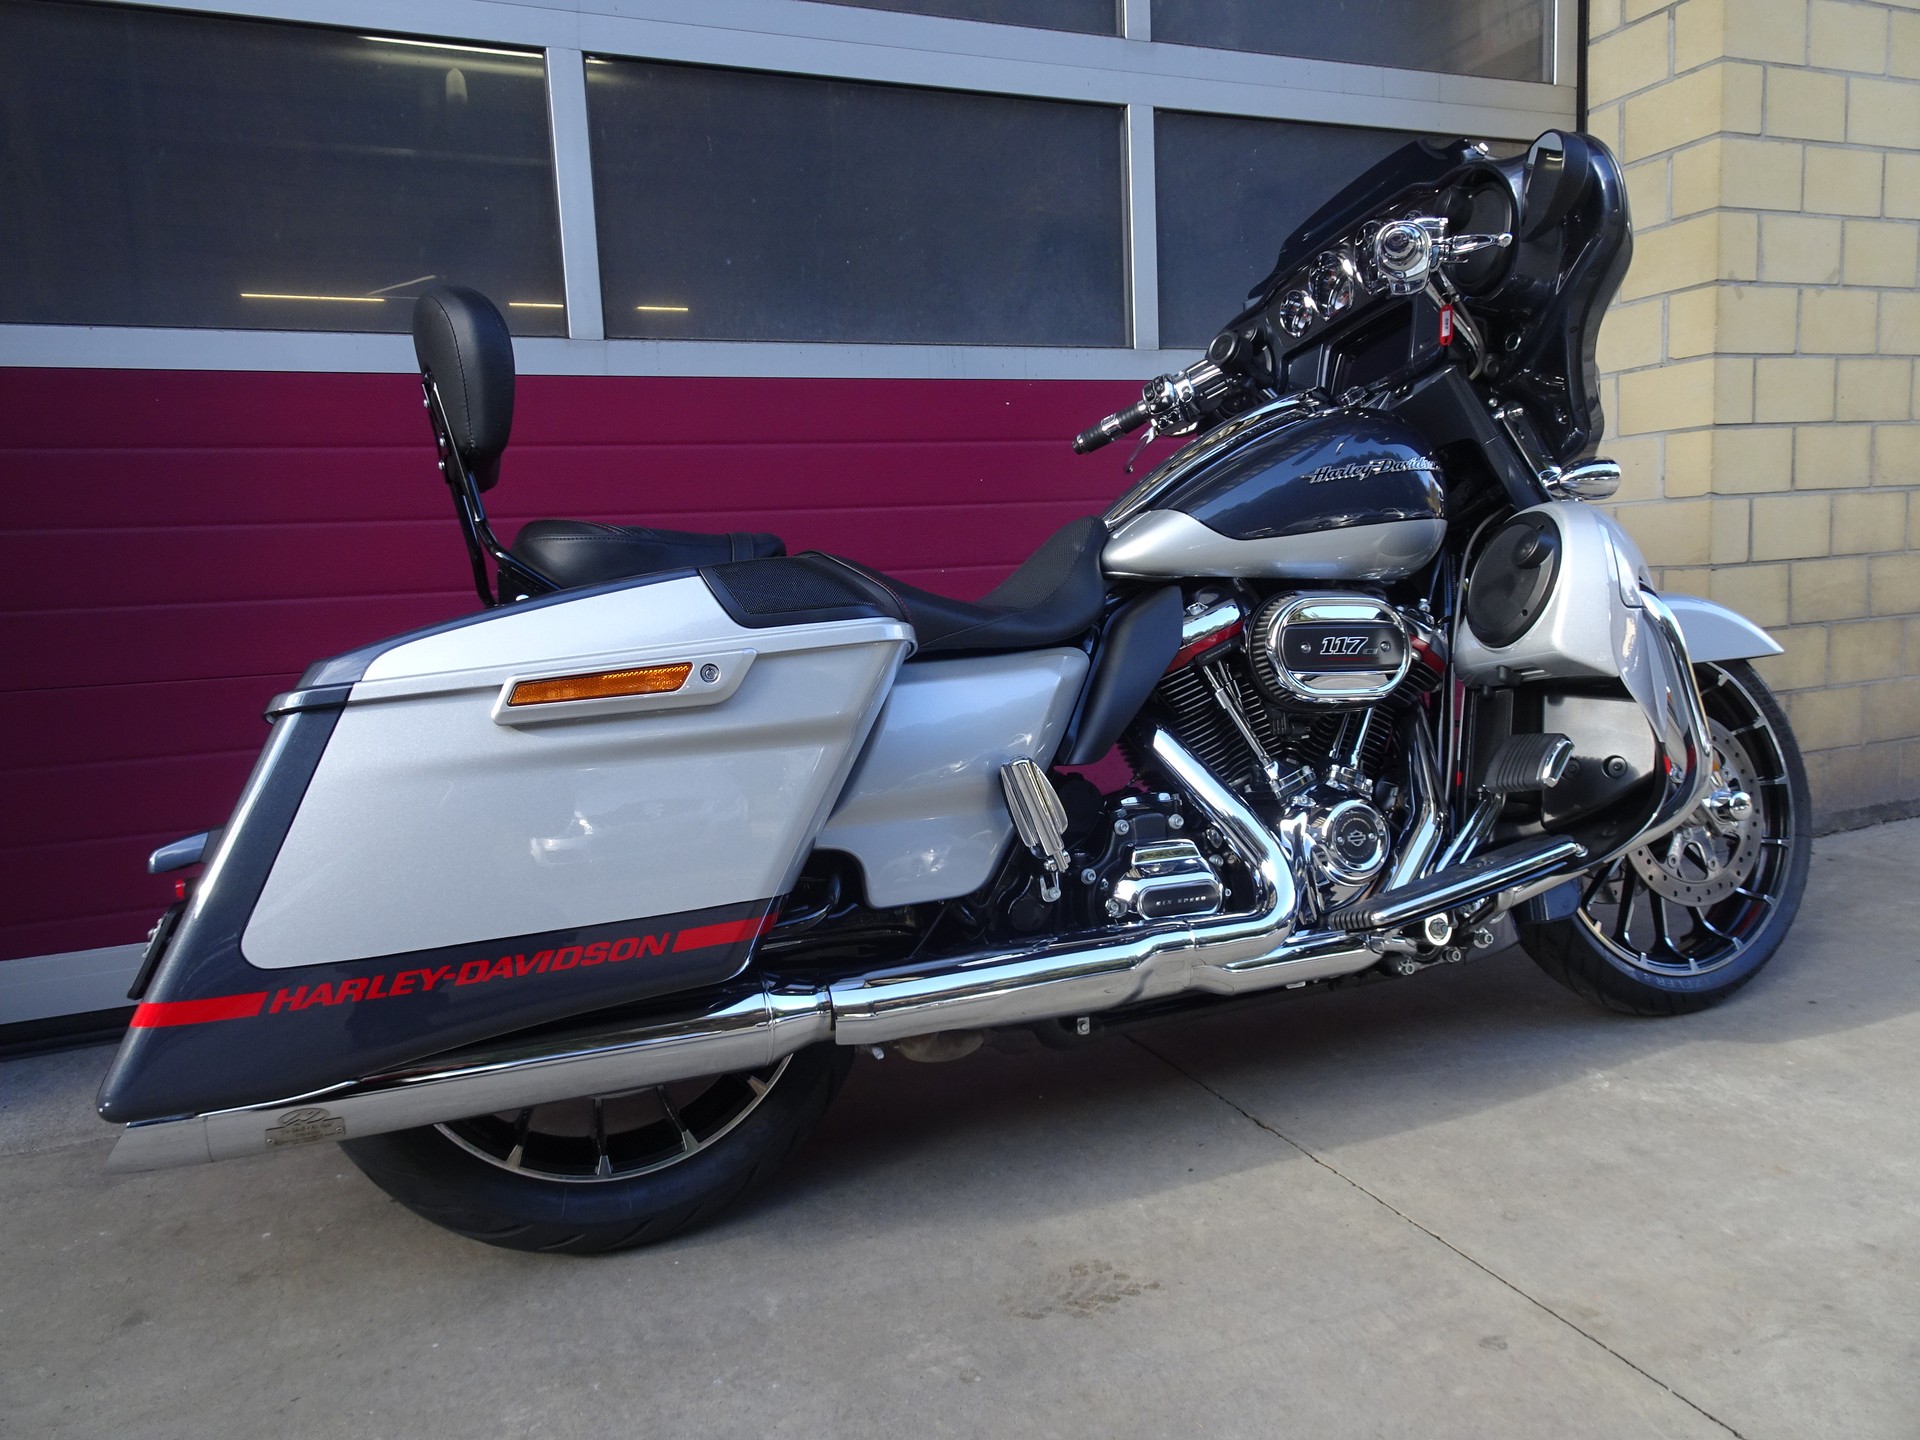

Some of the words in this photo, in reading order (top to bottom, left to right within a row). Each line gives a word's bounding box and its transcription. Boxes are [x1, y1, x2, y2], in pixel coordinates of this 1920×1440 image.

[1319, 636, 1369, 655] 117
[1155, 899, 1173, 907] SIX
[1177, 895, 1207, 904] SPEED
[268, 932, 671, 1015] HARLEY-DAVIDSON
